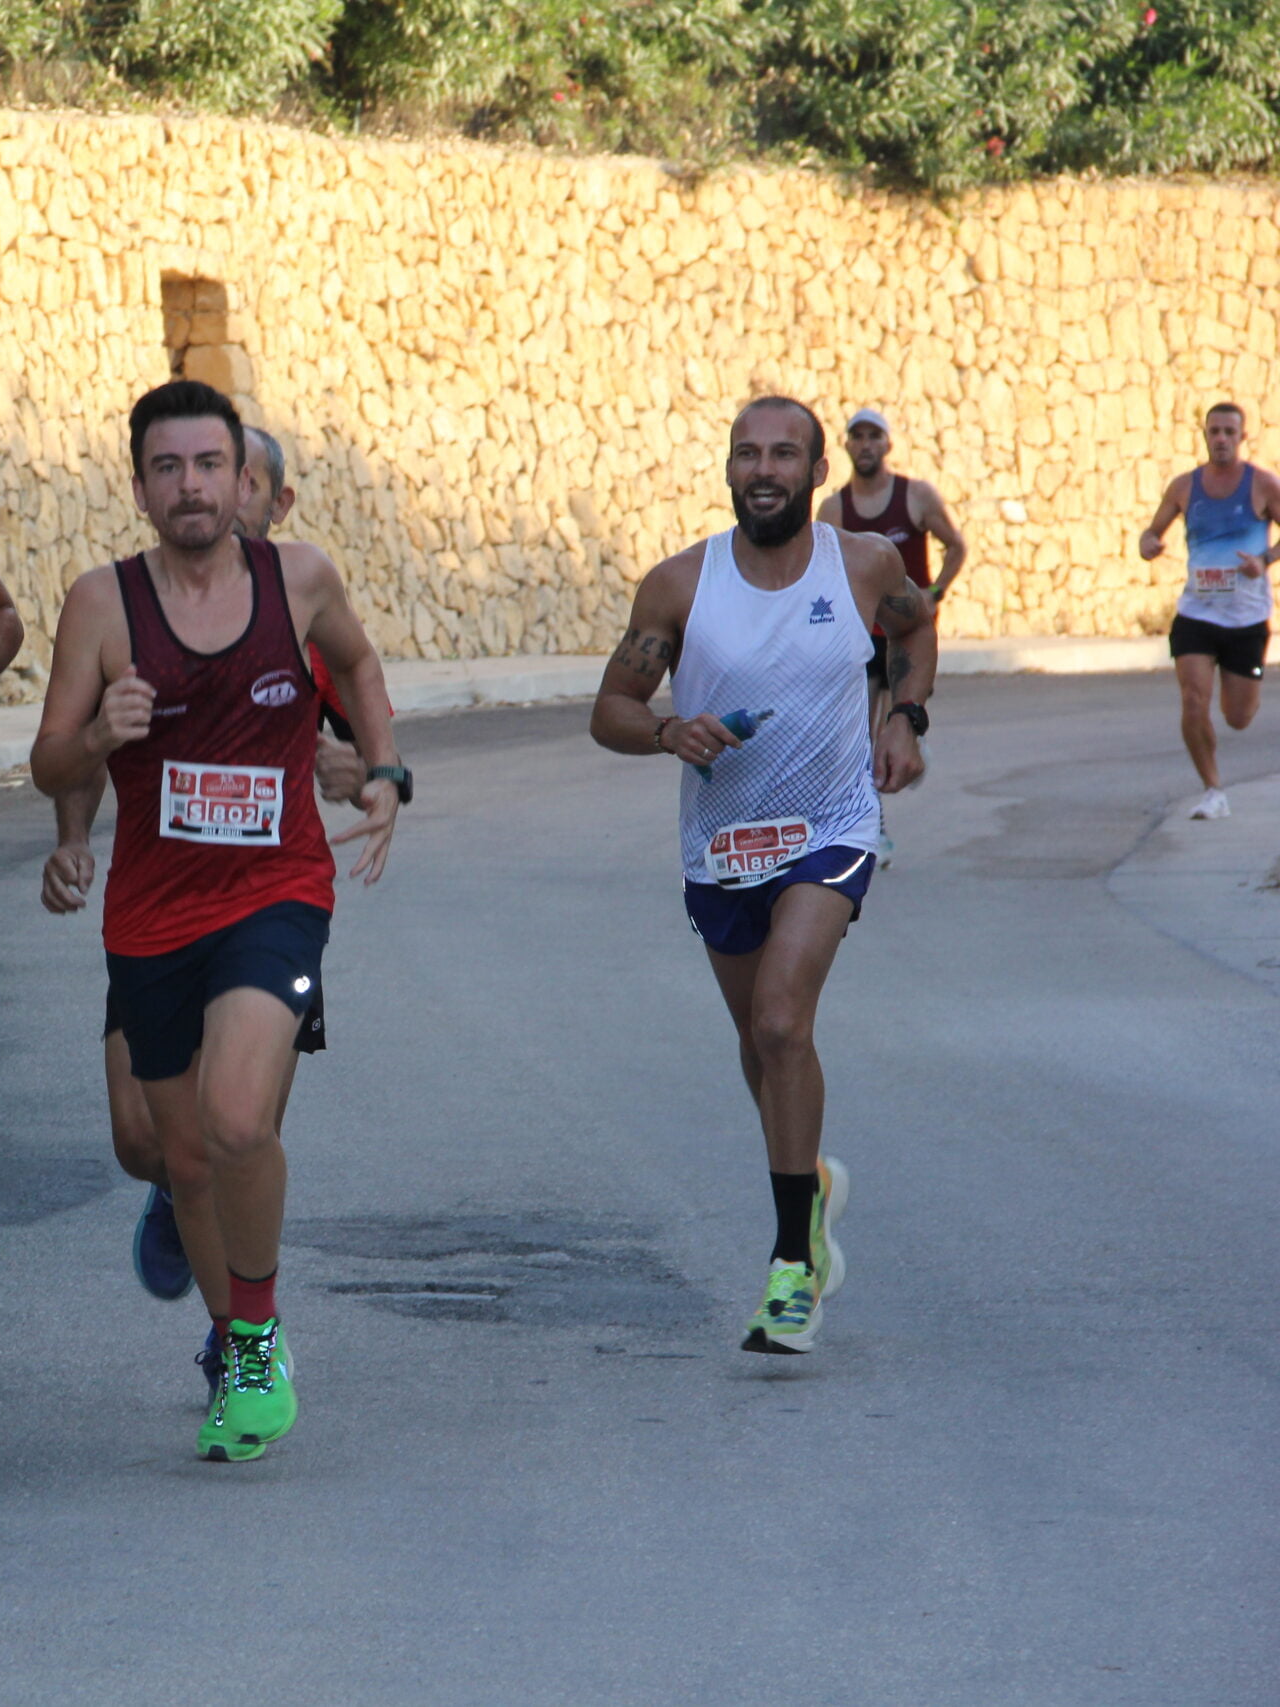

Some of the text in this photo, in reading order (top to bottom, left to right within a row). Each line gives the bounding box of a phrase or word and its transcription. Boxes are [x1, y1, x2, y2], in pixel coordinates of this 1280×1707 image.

[189, 803, 256, 824] S 802
[729, 858, 743, 873] A
